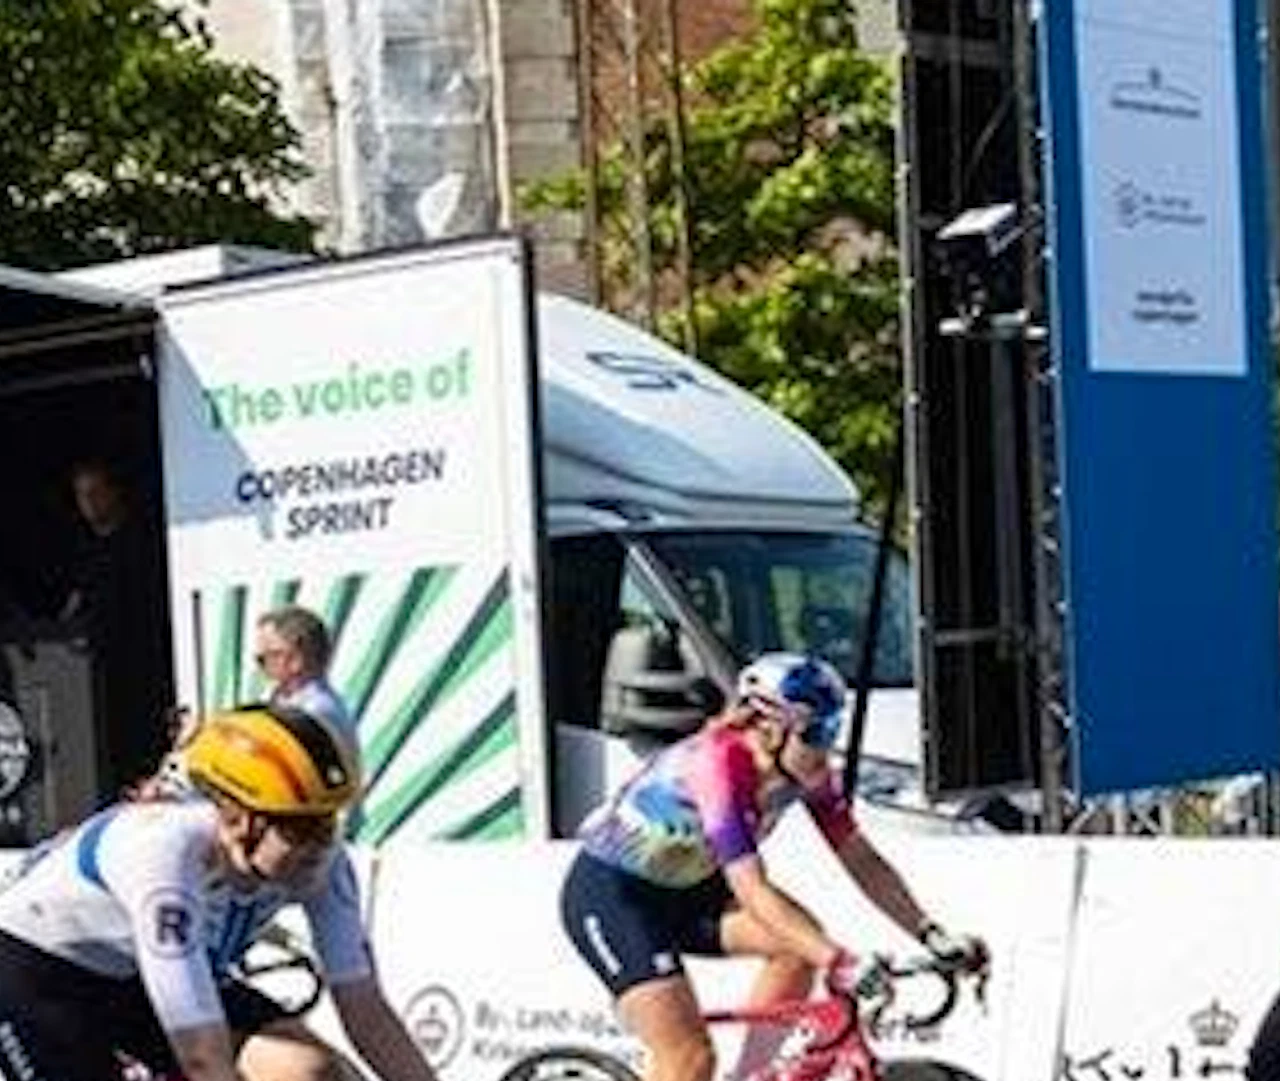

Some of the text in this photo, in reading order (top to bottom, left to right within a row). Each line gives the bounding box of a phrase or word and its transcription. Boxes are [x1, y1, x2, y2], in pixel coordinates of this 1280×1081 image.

[198, 348, 474, 432] The voice of
[234, 449, 445, 504] COPENHAGEN
[285, 496, 395, 540] SPRINT
[156, 905, 191, 945] R
